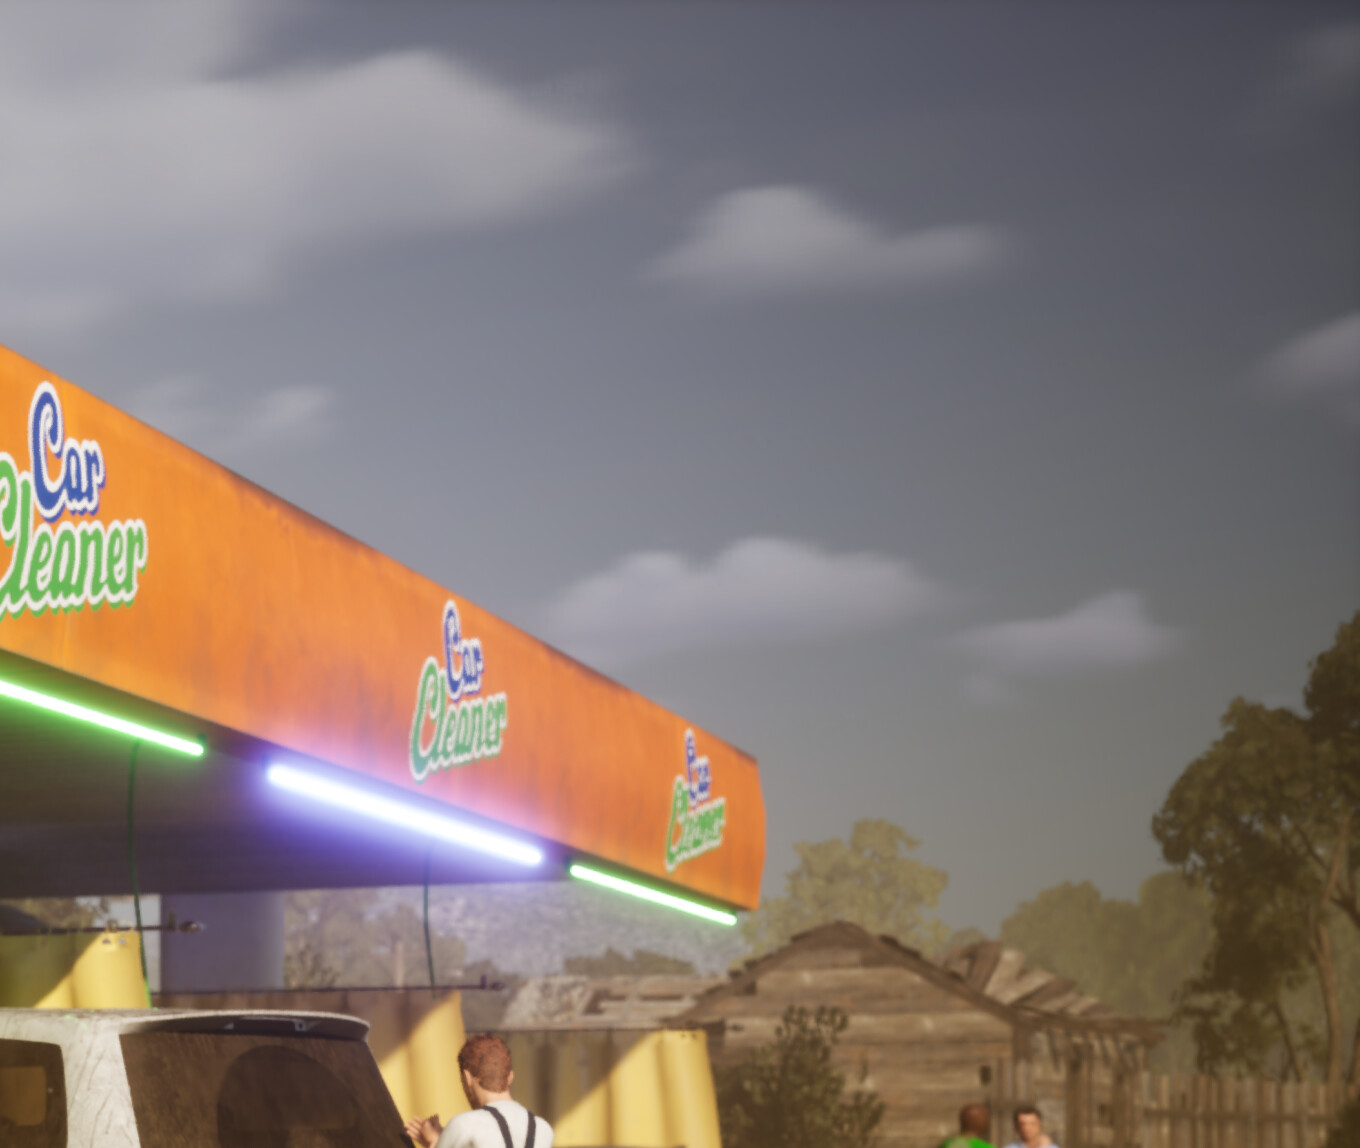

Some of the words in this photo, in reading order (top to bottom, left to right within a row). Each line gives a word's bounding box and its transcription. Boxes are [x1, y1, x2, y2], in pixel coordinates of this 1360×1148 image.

[28, 381, 105, 523] Car
[443, 599, 484, 702] Car
[410, 656, 507, 785] Cleaner
